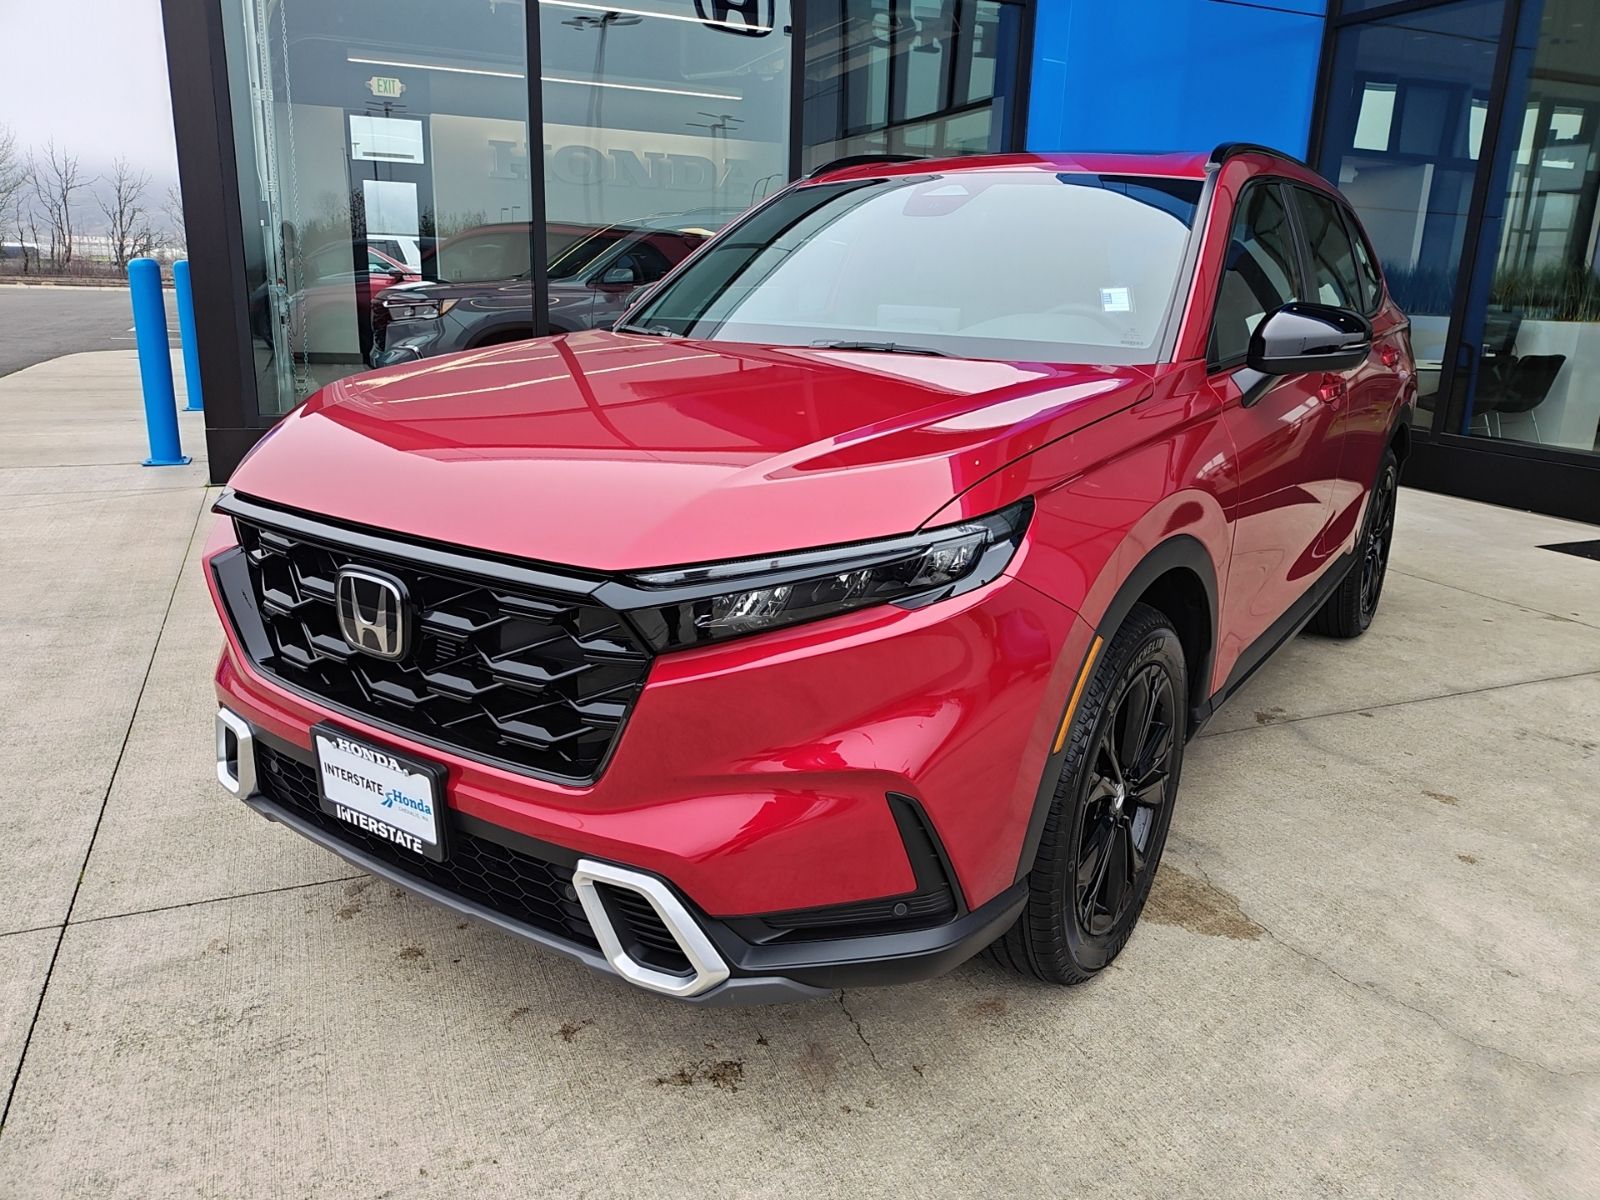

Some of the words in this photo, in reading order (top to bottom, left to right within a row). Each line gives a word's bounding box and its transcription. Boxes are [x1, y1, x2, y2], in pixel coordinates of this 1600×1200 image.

[377, 78, 396, 95] EXIT
[488, 139, 760, 195] HONDA
[1127, 637, 1165, 681] MICHELIN
[336, 737, 402, 773] HONDA
[323, 761, 384, 796] INTERSTATE
[392, 788, 432, 816] Honda
[336, 804, 423, 854] INTERSTATE
